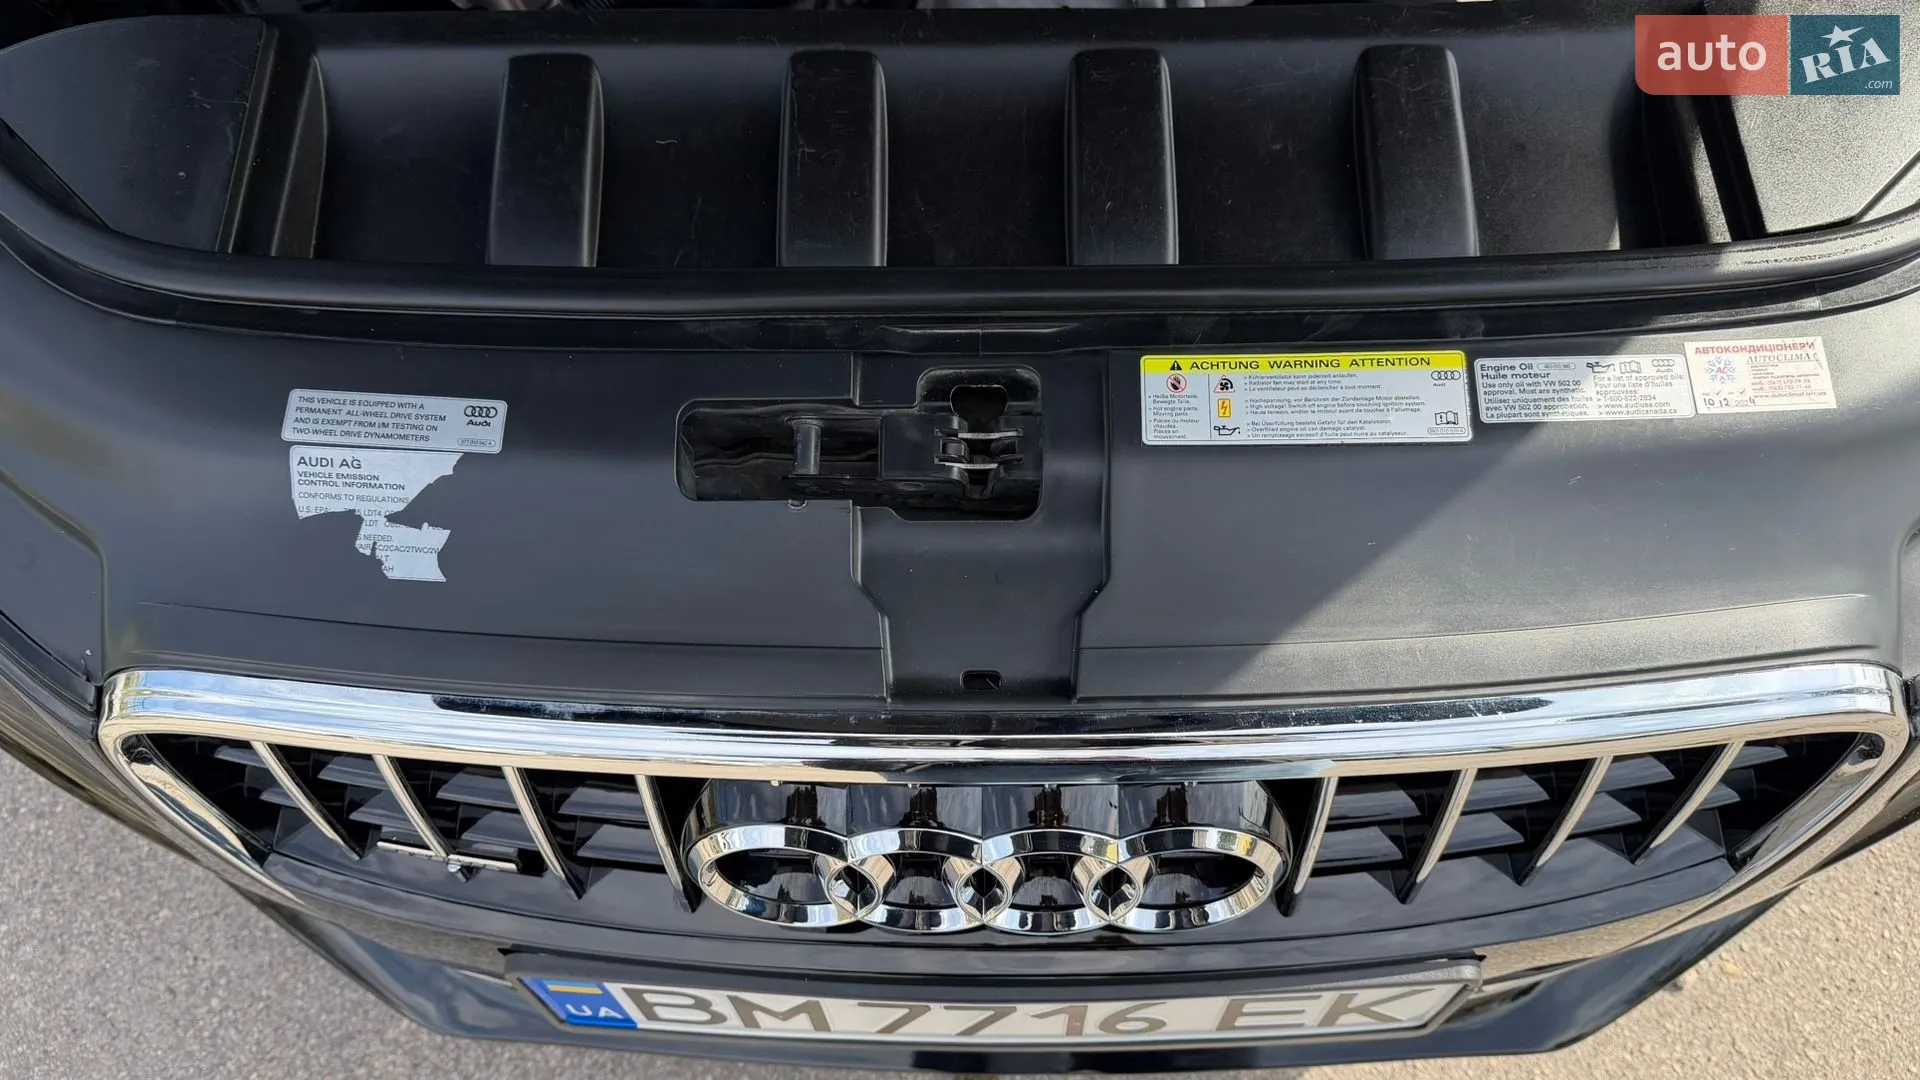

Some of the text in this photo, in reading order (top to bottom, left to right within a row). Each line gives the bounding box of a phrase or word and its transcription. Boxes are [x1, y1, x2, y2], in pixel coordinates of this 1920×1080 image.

[1190, 358, 1430, 370] ACHTUNG WARNING ATTENTION
[1480, 364, 1516, 372] Engine
[317, 397, 347, 405] VEHICLE
[358, 399, 396, 408] EQUIPPED
[296, 406, 342, 415] PERMANENT
[346, 410, 388, 418] ALL-WHEEL
[321, 418, 352, 427] EXEMPT
[392, 422, 424, 430] TESTING
[292, 427, 430, 441] TWO-WHEEL DRIVE DYNAMOMETERS
[297, 456, 362, 469] AUDI AG
[297, 471, 380, 481] VEHICLE EMISSION
[298, 479, 405, 490] CONTROL INFORMATION
[299, 492, 342, 501] CONFORMS
[356, 494, 409, 503] REGULATIONS
[565, 1004, 622, 1019] UA
[623, 987, 1435, 1037] BM 7716 EK
